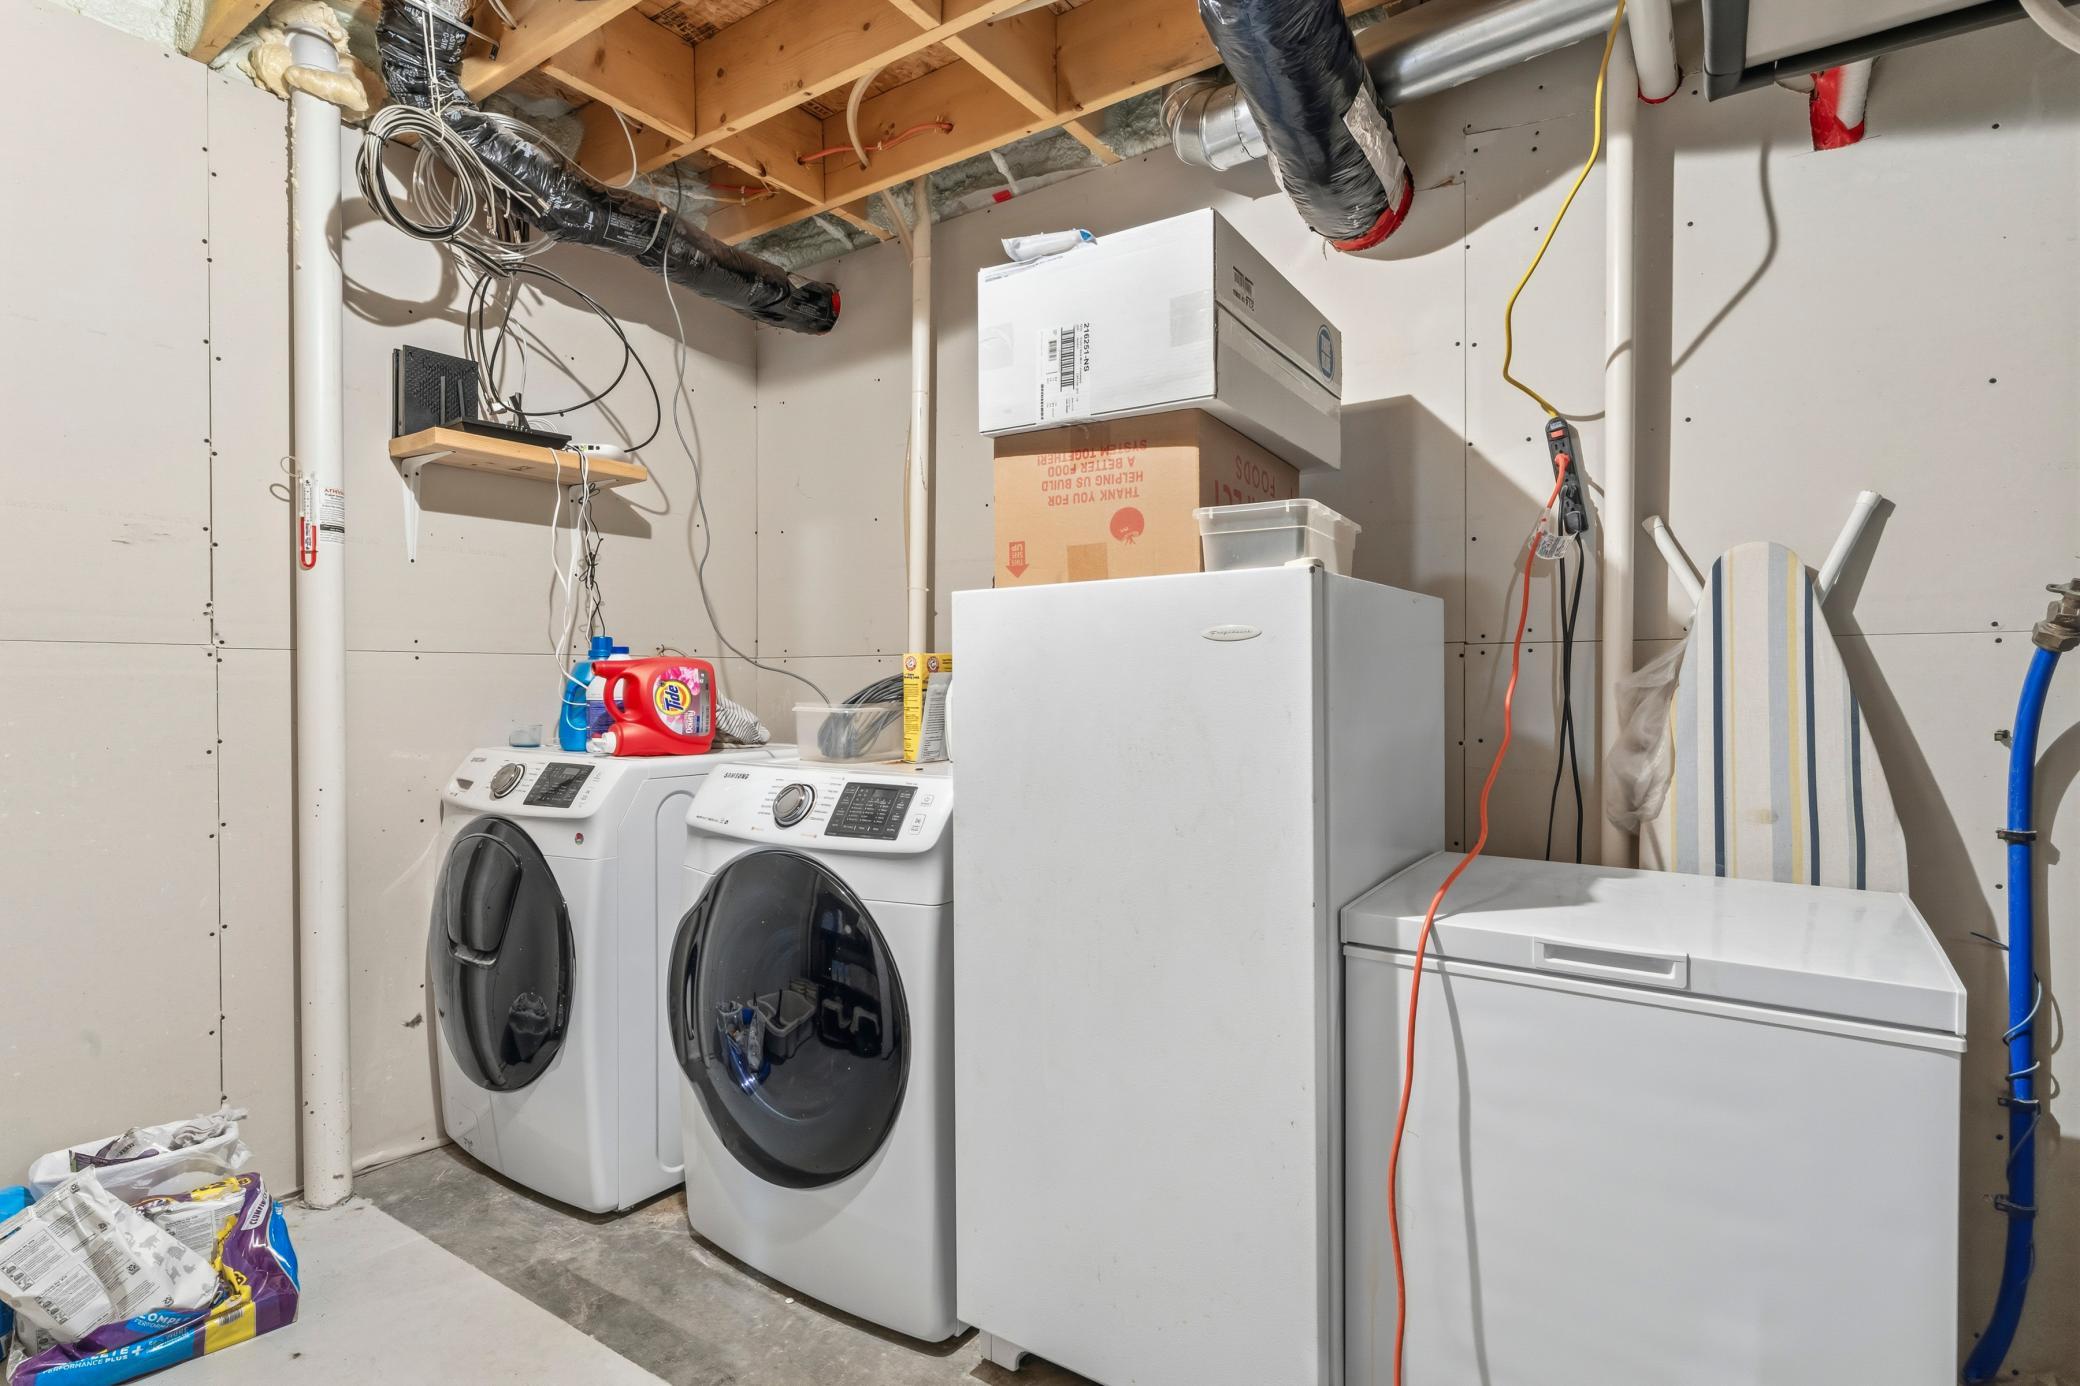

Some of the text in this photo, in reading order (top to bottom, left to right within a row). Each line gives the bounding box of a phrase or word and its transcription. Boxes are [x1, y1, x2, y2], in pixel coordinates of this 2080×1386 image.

[1100, 440, 1148, 456] SYSTEM
[1047, 456, 1136, 477] A BETTER FOOD
[1041, 471, 1143, 492] HELPING US BUILD
[1235, 455, 1276, 499] FOODS
[1048, 487, 1139, 506] THANK YOU FOR
[664, 684, 684, 711] Tide
[724, 772, 750, 780] SAMSUNG
[104, 1354, 128, 1364] PLUS
